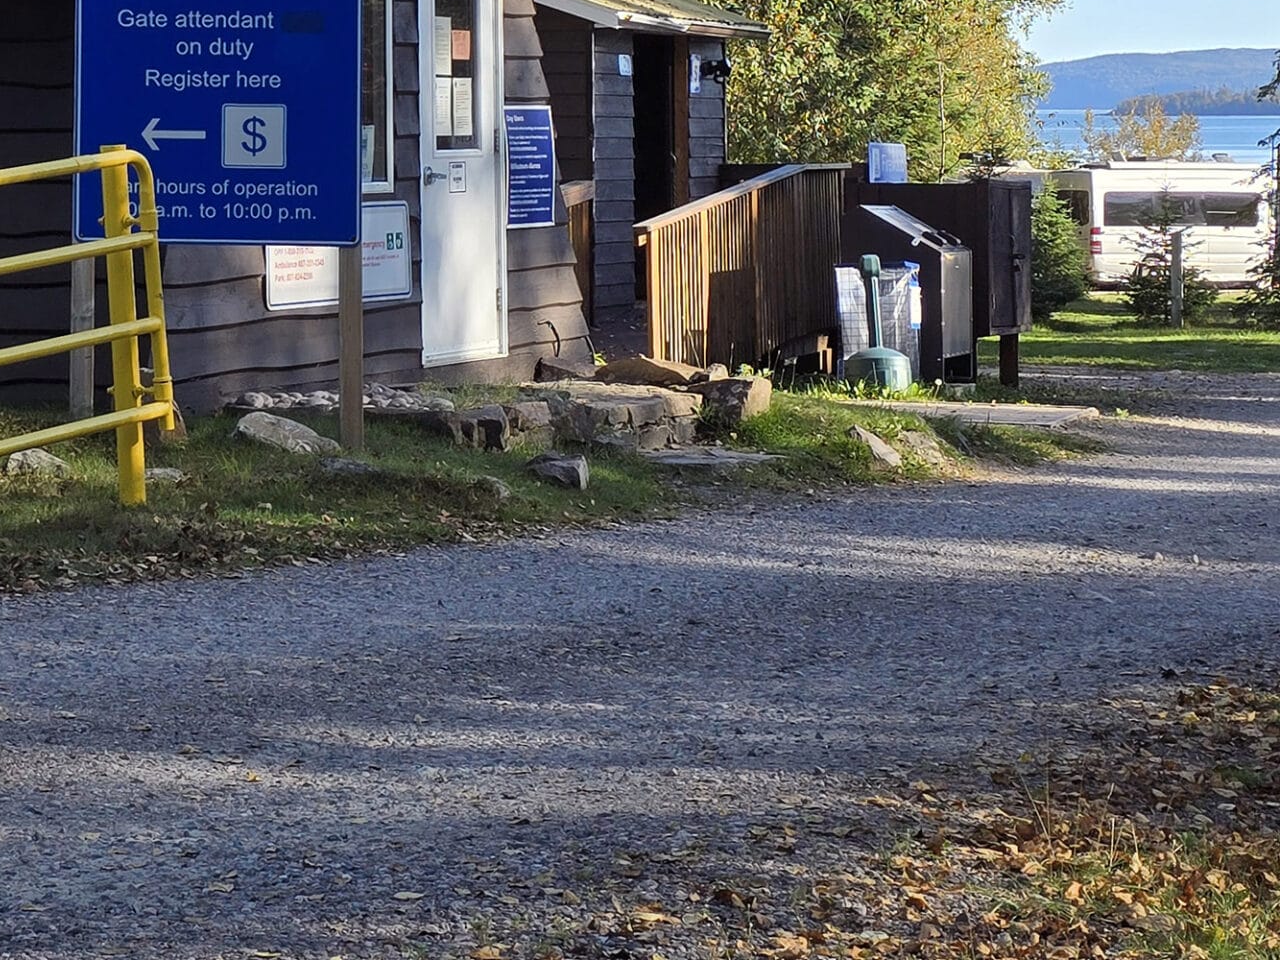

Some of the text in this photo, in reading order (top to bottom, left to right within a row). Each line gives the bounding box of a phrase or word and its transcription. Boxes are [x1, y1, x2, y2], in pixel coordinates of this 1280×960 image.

[117, 8, 275, 30] Gate attendant
[175, 36, 255, 61] on duty
[145, 68, 282, 92] Register here
[156, 178, 207, 195] hours
[211, 178, 230, 196] of
[233, 180, 319, 199] operation
[156, 204, 193, 218] a.m.
[199, 202, 217, 219] to
[223, 202, 273, 220] 10:00
[278, 207, 317, 224] p.m.
